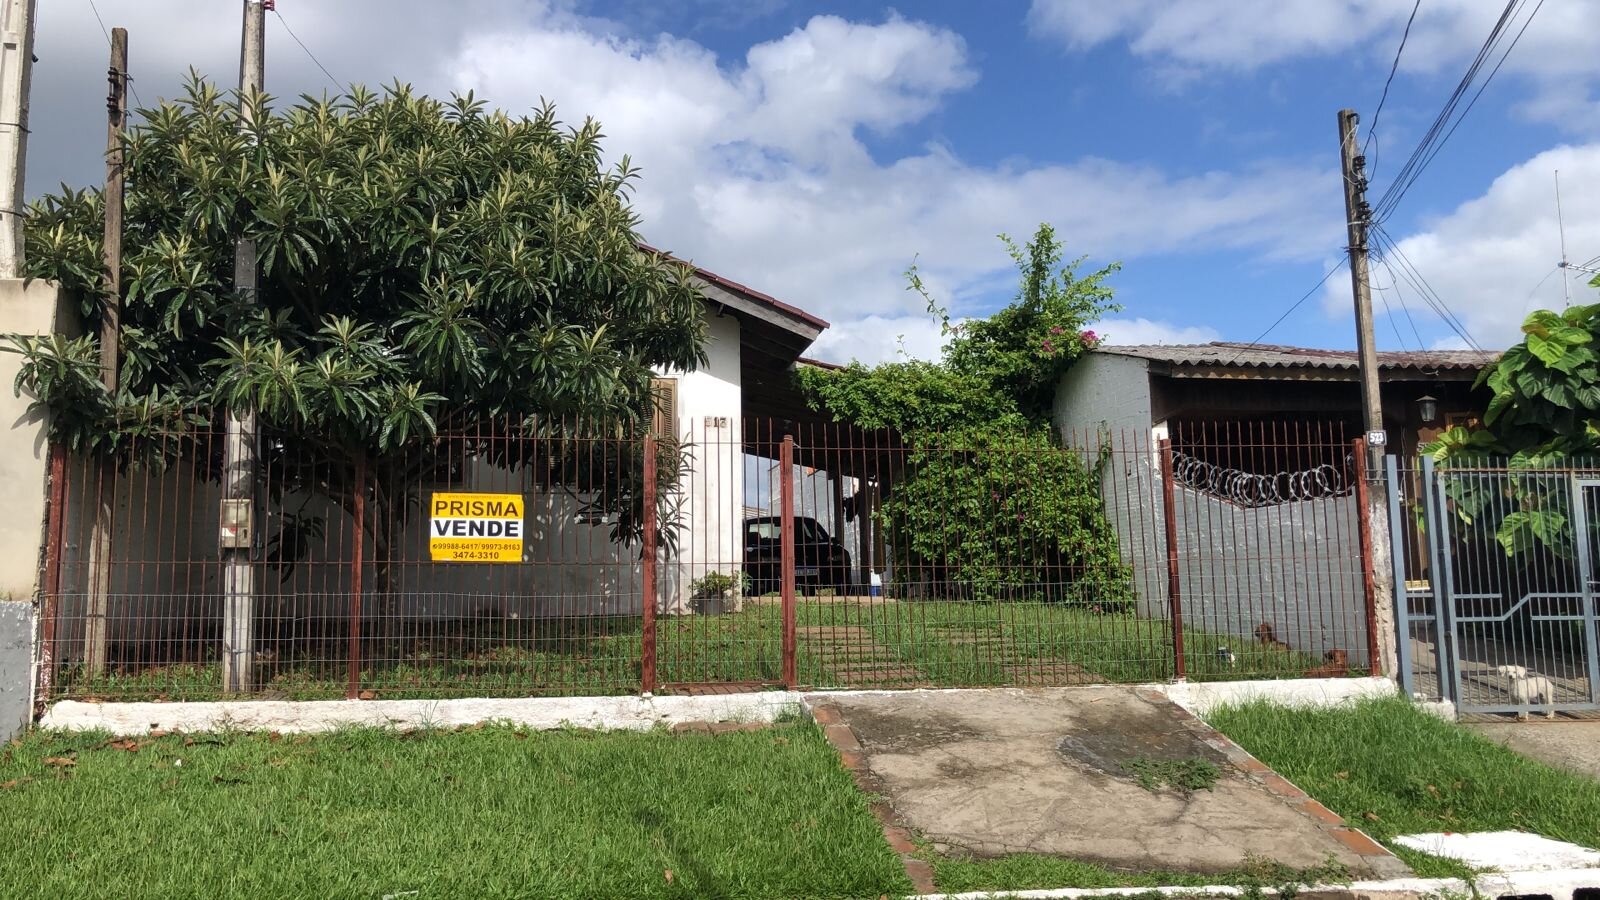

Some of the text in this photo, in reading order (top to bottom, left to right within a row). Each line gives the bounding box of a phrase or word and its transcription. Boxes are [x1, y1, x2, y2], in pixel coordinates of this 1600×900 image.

[1369, 432, 1384, 442] 523
[435, 500, 519, 516] PRISMA
[434, 520, 519, 537] VENDE
[453, 551, 499, 559] 3474-3310
